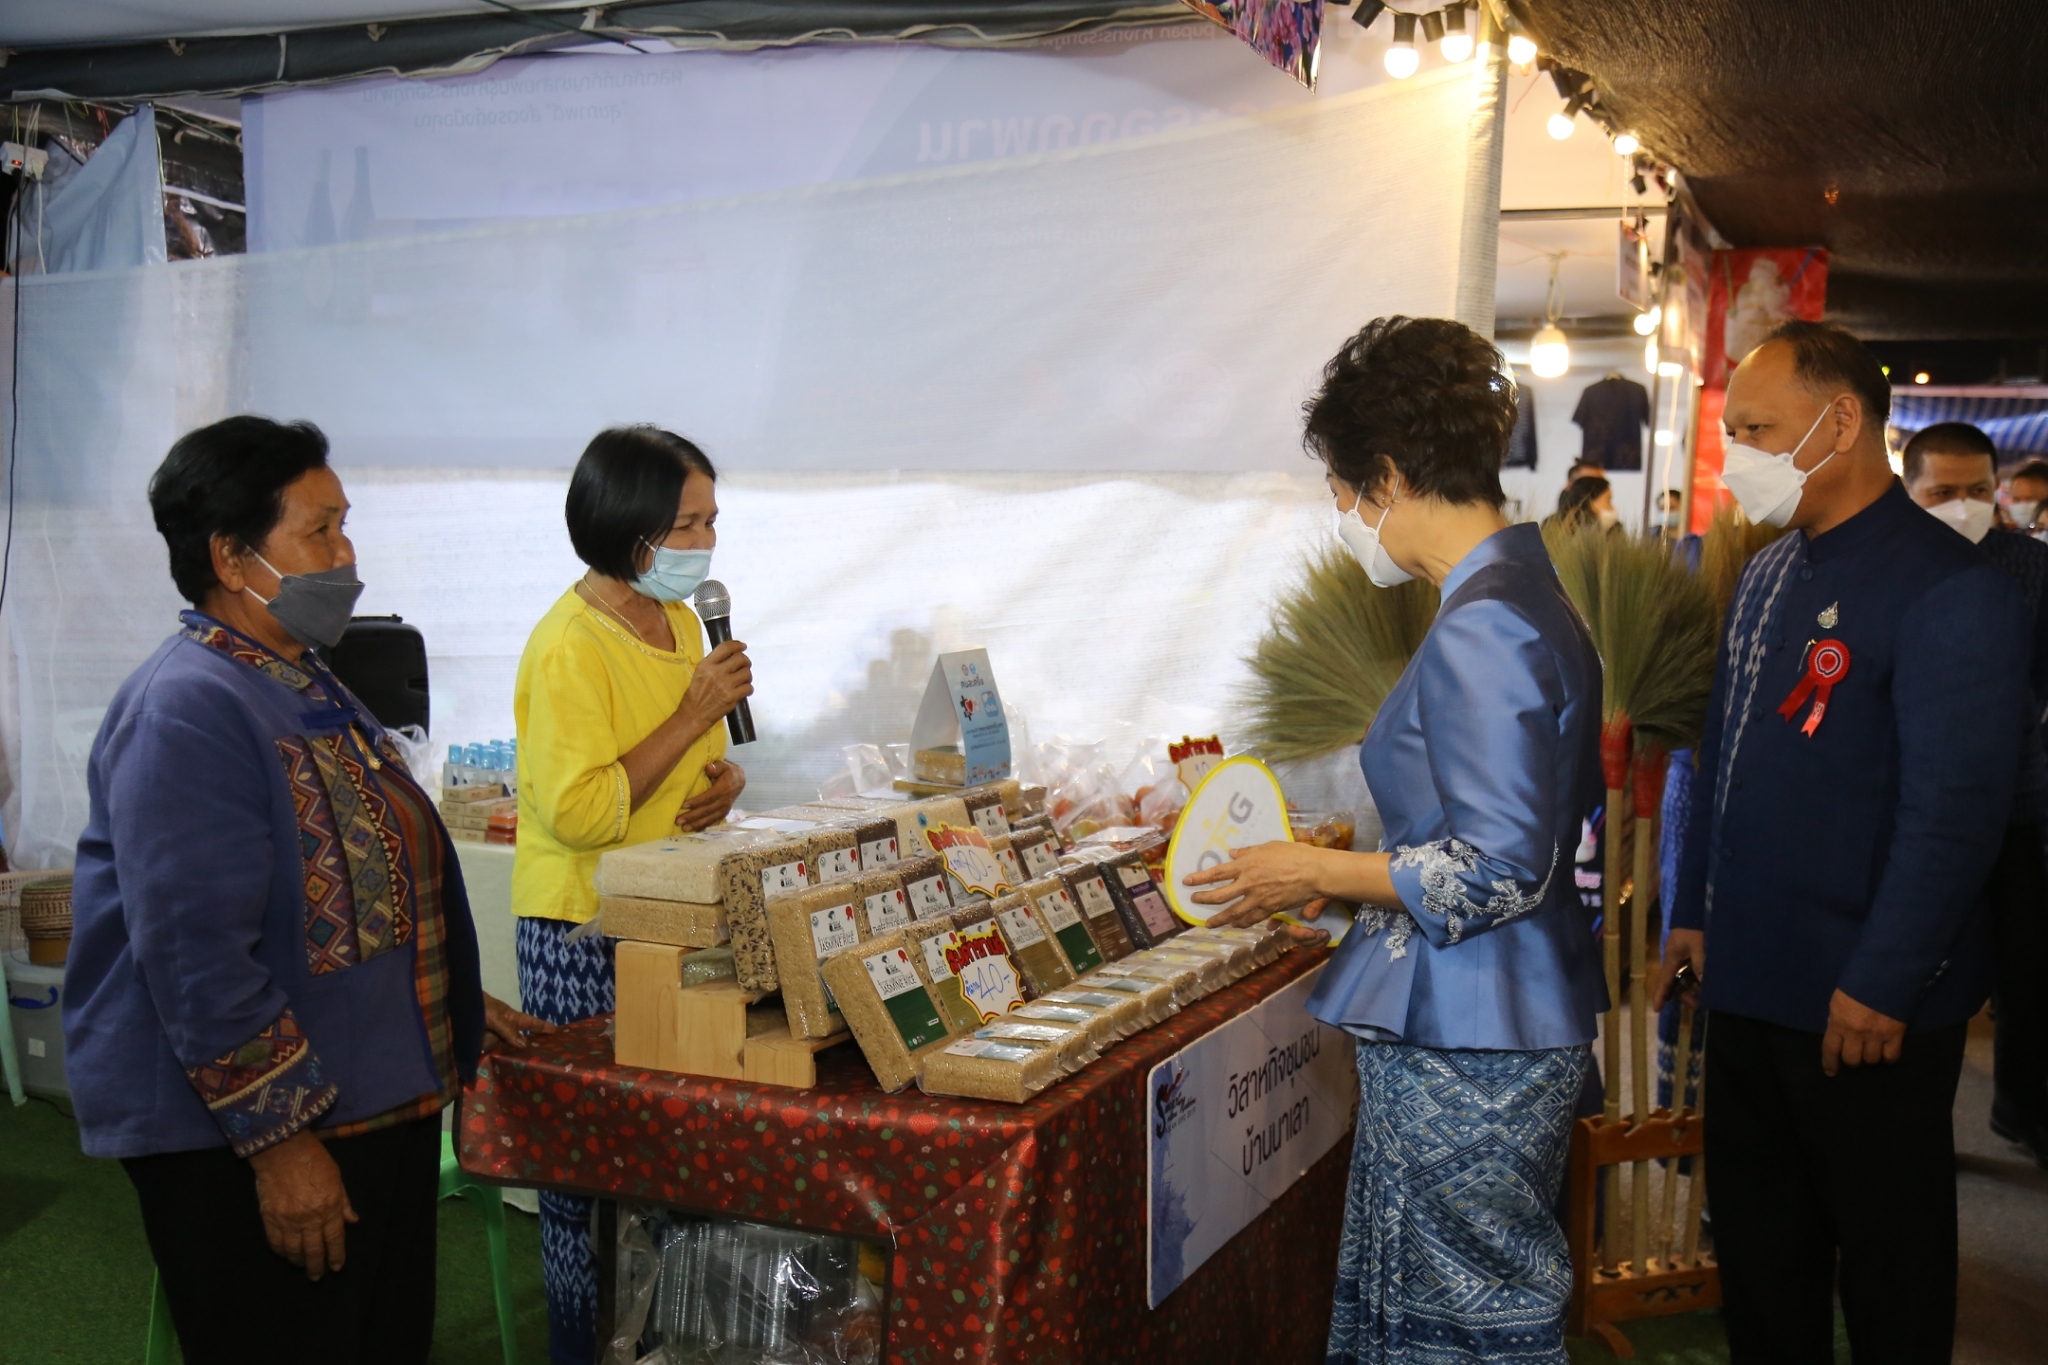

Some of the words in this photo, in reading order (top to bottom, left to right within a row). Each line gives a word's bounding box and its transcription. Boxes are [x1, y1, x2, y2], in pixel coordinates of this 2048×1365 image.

[819, 938, 843, 954] JASMINE
[843, 935, 855, 947] RICE
[880, 979, 905, 995] JASMINE
[905, 975, 917, 988] RICE
[1228, 1025, 1320, 1119] วิสาหกิจชุมชน
[1243, 1096, 1309, 1176] บ้านนาเลา
